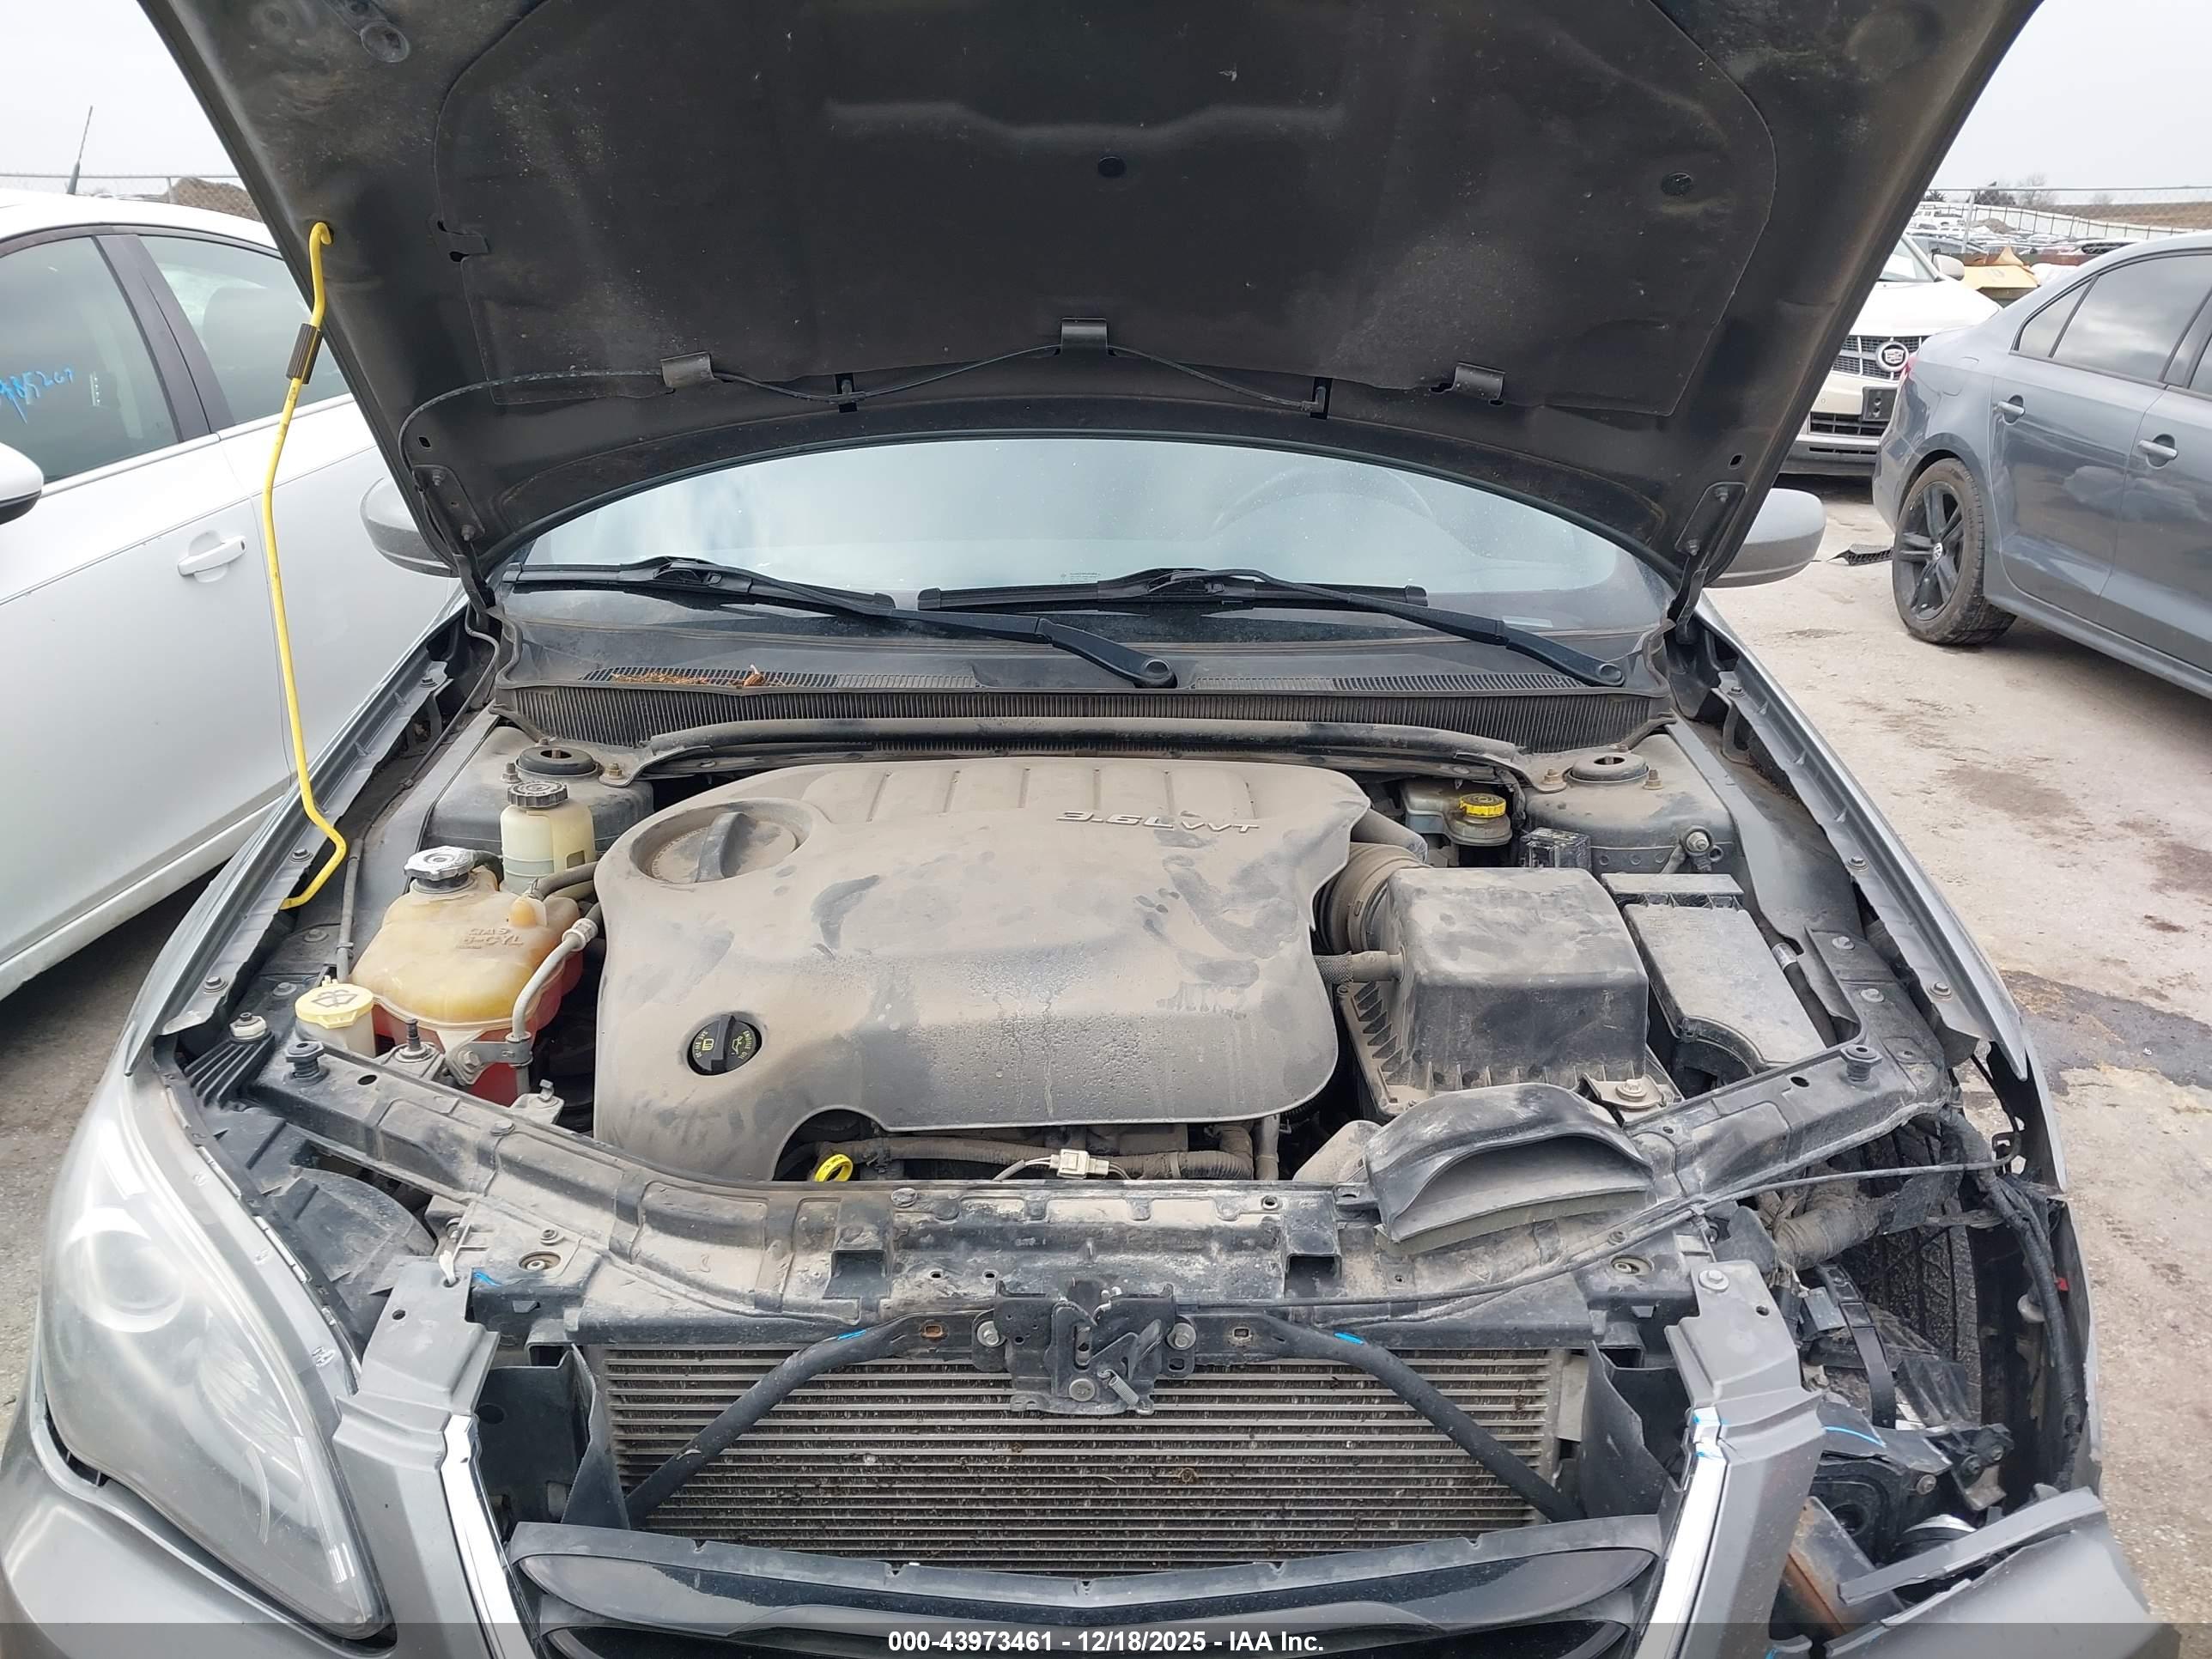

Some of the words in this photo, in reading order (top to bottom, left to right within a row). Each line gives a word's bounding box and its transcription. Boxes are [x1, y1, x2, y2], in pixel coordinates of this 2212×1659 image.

[1056, 810, 1175, 832] 3.6L
[1180, 820, 1261, 834] VVT
[743, 1030, 752, 1050] ENGINE
[738, 1051, 748, 1060] OIL
